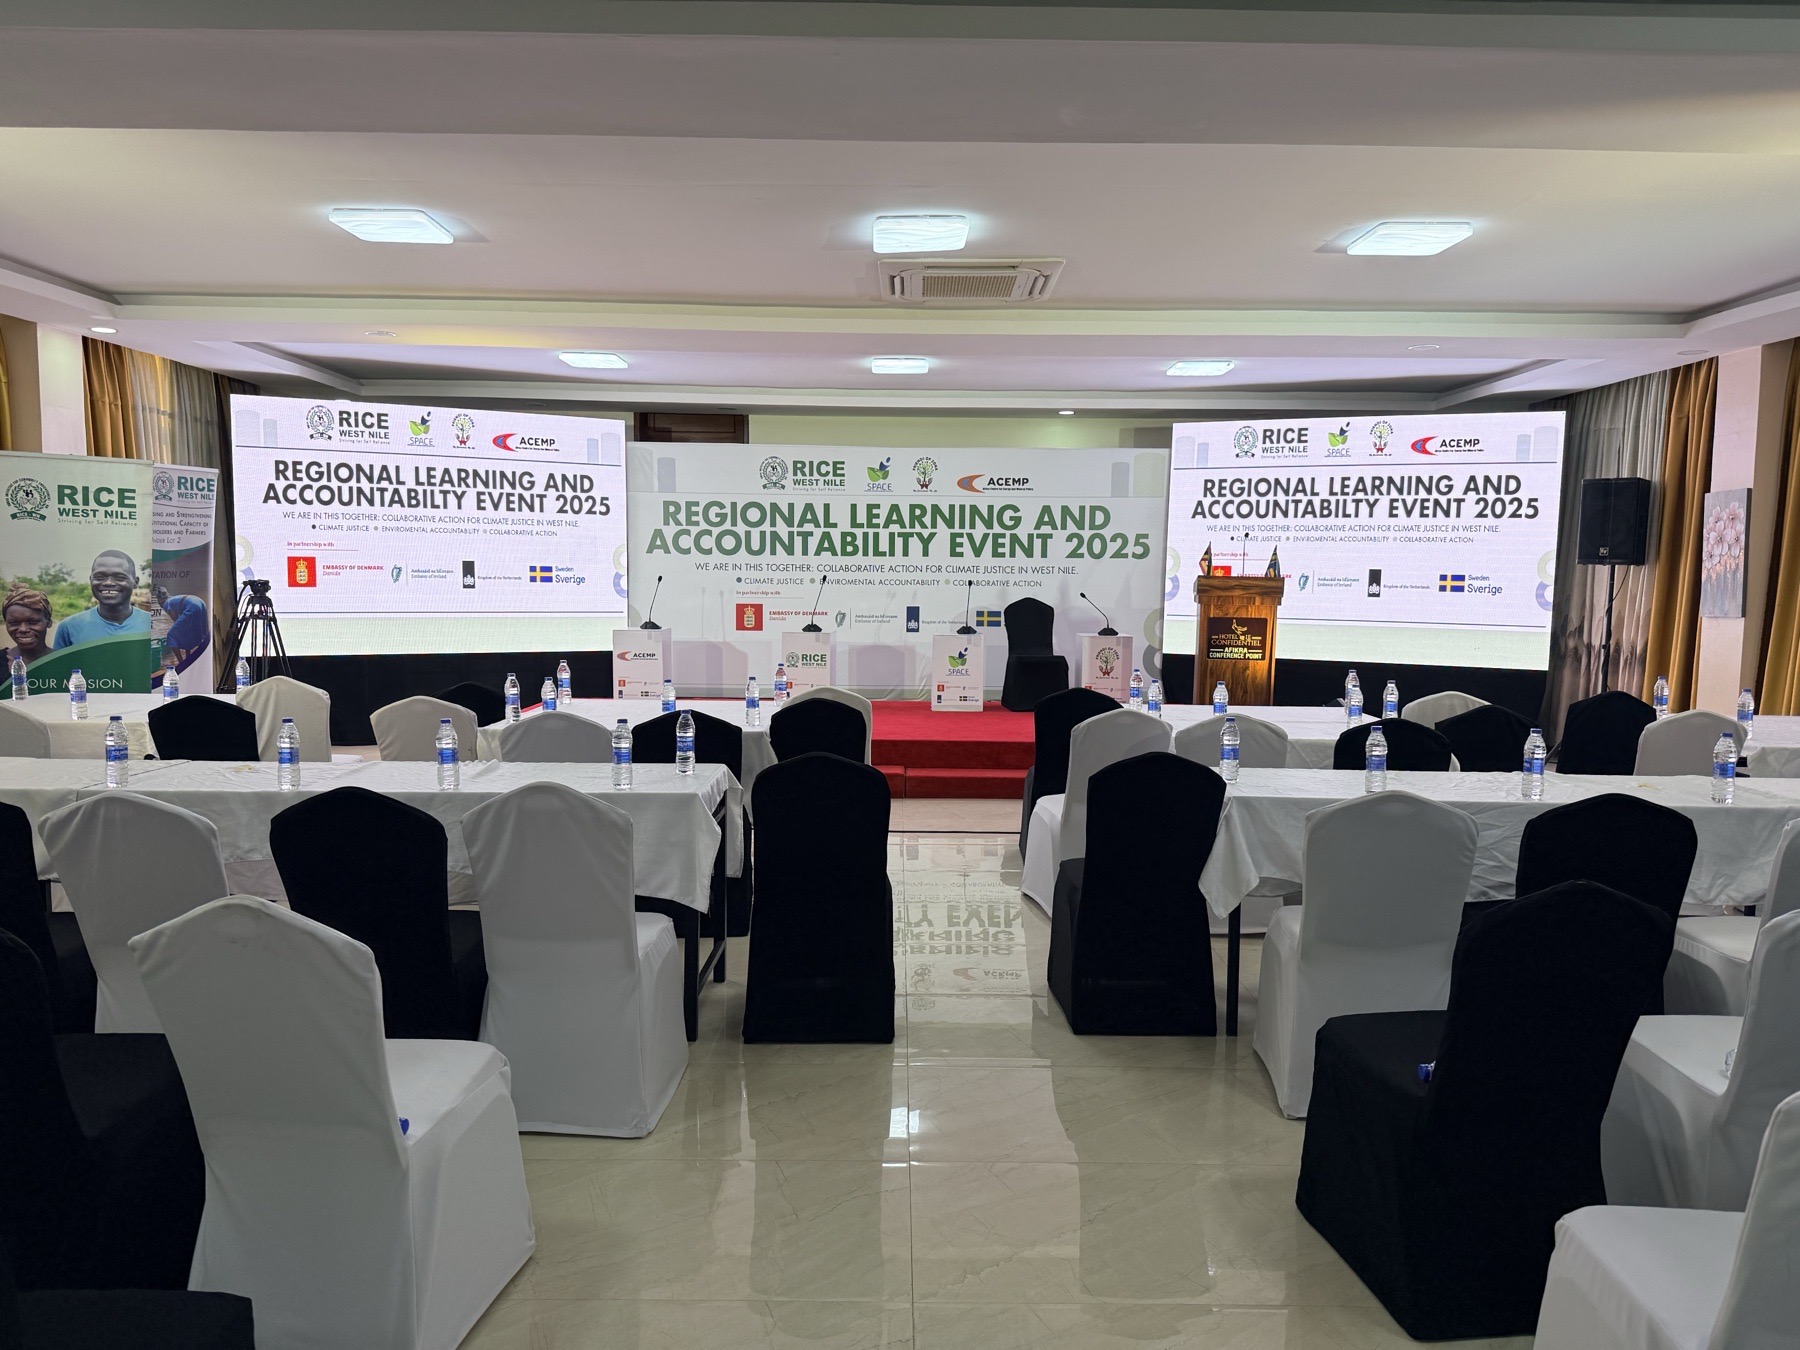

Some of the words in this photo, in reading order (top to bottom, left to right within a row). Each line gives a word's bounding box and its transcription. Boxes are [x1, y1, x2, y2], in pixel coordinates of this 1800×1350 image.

[338, 410, 389, 429] RICE
[339, 429, 365, 438] WEST
[369, 431, 390, 440] NILE
[1262, 427, 1308, 445] RICE
[410, 437, 433, 446] SPACE
[519, 437, 555, 447] ACEMP
[1440, 439, 1480, 448] ACEMP
[1261, 446, 1286, 454] WEST
[1288, 445, 1308, 453] NILE
[1327, 448, 1350, 456] SPACE
[792, 460, 845, 477] RICE
[274, 459, 406, 485] REGIONAL
[414, 466, 536, 491] LEARNING
[543, 472, 594, 494] AND
[987, 477, 1029, 486] ACEMP
[177, 475, 215, 492] RICE
[823, 479, 845, 487] NILE
[867, 483, 892, 491] SPACE
[1203, 477, 1319, 497] REGIONAL
[1328, 475, 1454, 496] LEARNING
[1462, 474, 1522, 496] AND
[57, 484, 137, 509] RICE
[262, 483, 467, 510] ACCOUNTABILTY
[476, 491, 547, 513] EVENT
[555, 493, 611, 516] 2025
[1191, 498, 1380, 519] ACCOUNTABILTY
[1388, 498, 1465, 518] EVENT
[1474, 497, 1539, 519] 2025
[58, 508, 99, 518] WEST
[104, 509, 137, 520] NILE
[297, 511, 311, 519] ARE
[324, 512, 339, 520] THIS
[340, 513, 380, 522] TOGETHER:
[382, 514, 436, 523] COLLABORATIVE
[438, 516, 465, 524] ACTION
[482, 517, 509, 525] CLIMATE
[510, 518, 535, 526] JUSTICE
[545, 519, 563, 527] WEST
[662, 500, 838, 529] REGIONAL
[849, 503, 1023, 530] LEARNING
[1033, 505, 1111, 531] AND
[1242, 524, 1256, 532] THIS
[1257, 524, 1292, 532] TOGETHER:
[1294, 524, 1348, 532] COLLABORATIVE
[1349, 524, 1375, 532] ACTION
[1377, 524, 1391, 532] FOR
[1393, 524, 1421, 532] CLIMATE
[1422, 524, 1449, 533] JUSTICE
[1451, 525, 1459, 533] IN
[1461, 525, 1482, 533] WEST
[1483, 525, 1500, 533] NILE.
[645, 528, 938, 557] ACCOUNTABILITY
[950, 532, 1053, 558] EVENT
[1064, 532, 1151, 559] 2025
[695, 562, 710, 571] WE
[712, 563, 729, 571] ARE
[732, 563, 742, 572] IN
[744, 563, 763, 572] THIS
[765, 563, 814, 573] TOGETHER:
[816, 564, 885, 573] COLLABORATIVE
[887, 564, 923, 573] ACTION
[925, 565, 943, 574] FOR
[945, 565, 981, 574] CLIMATE
[982, 565, 1015, 575] JUSTICE
[1018, 566, 1028, 575] IN
[1030, 566, 1055, 575] WEST
[1057, 566, 1078, 575] NILE.
[555, 574, 586, 585] Sverige
[744, 577, 775, 585] CLIMATE
[776, 577, 804, 585] JUSTICE
[878, 578, 940, 586] ACCOUNTABILITY
[952, 579, 1011, 587] COLABORATIVE
[1467, 584, 1502, 596] Sverige
[801, 654, 827, 662] RICE
[27, 678, 57, 689] OUR
